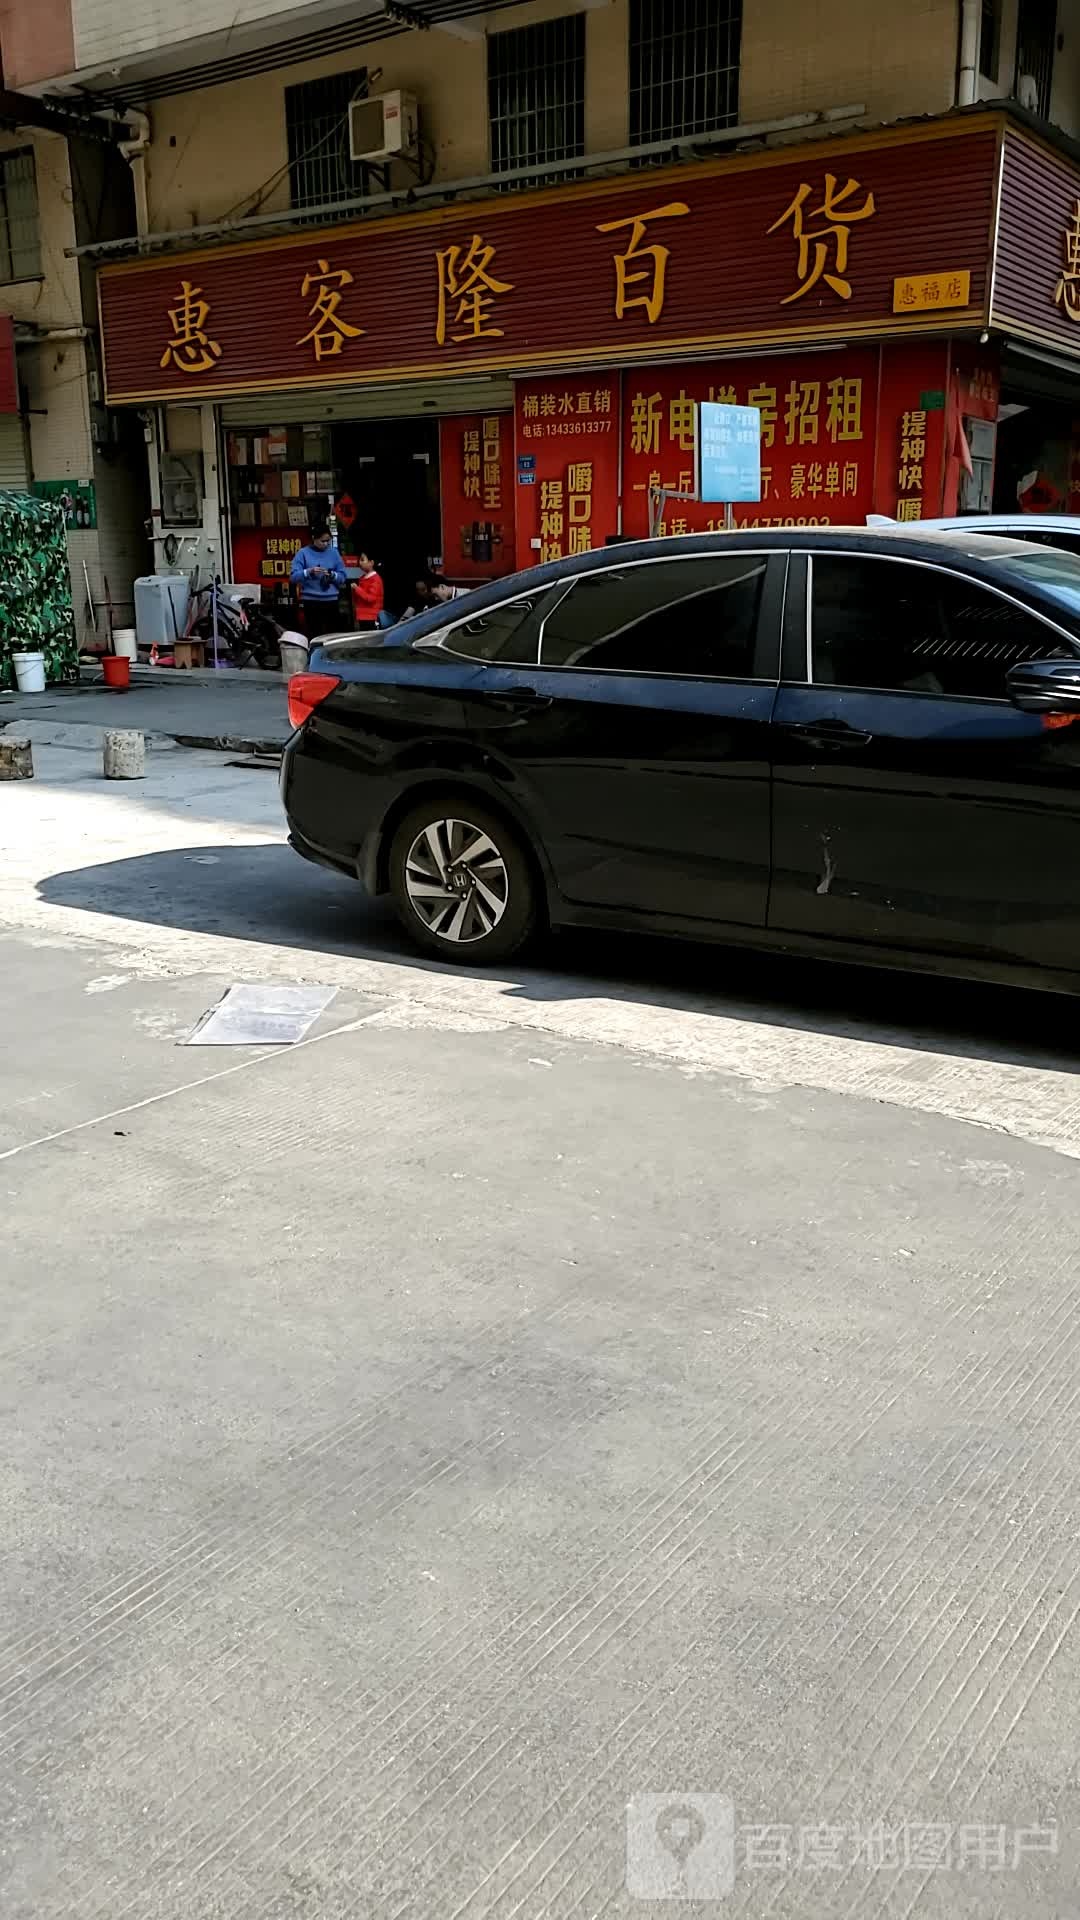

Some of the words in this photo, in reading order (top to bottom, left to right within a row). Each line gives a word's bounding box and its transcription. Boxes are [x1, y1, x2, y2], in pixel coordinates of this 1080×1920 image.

[160, 173, 876, 373] 惠客隆百货
[899, 277, 961, 305] 惠福店
[522, 389, 612, 418] 桶装水直销
[463, 431, 481, 498] 提神快
[898, 411, 927, 490] 提神快
